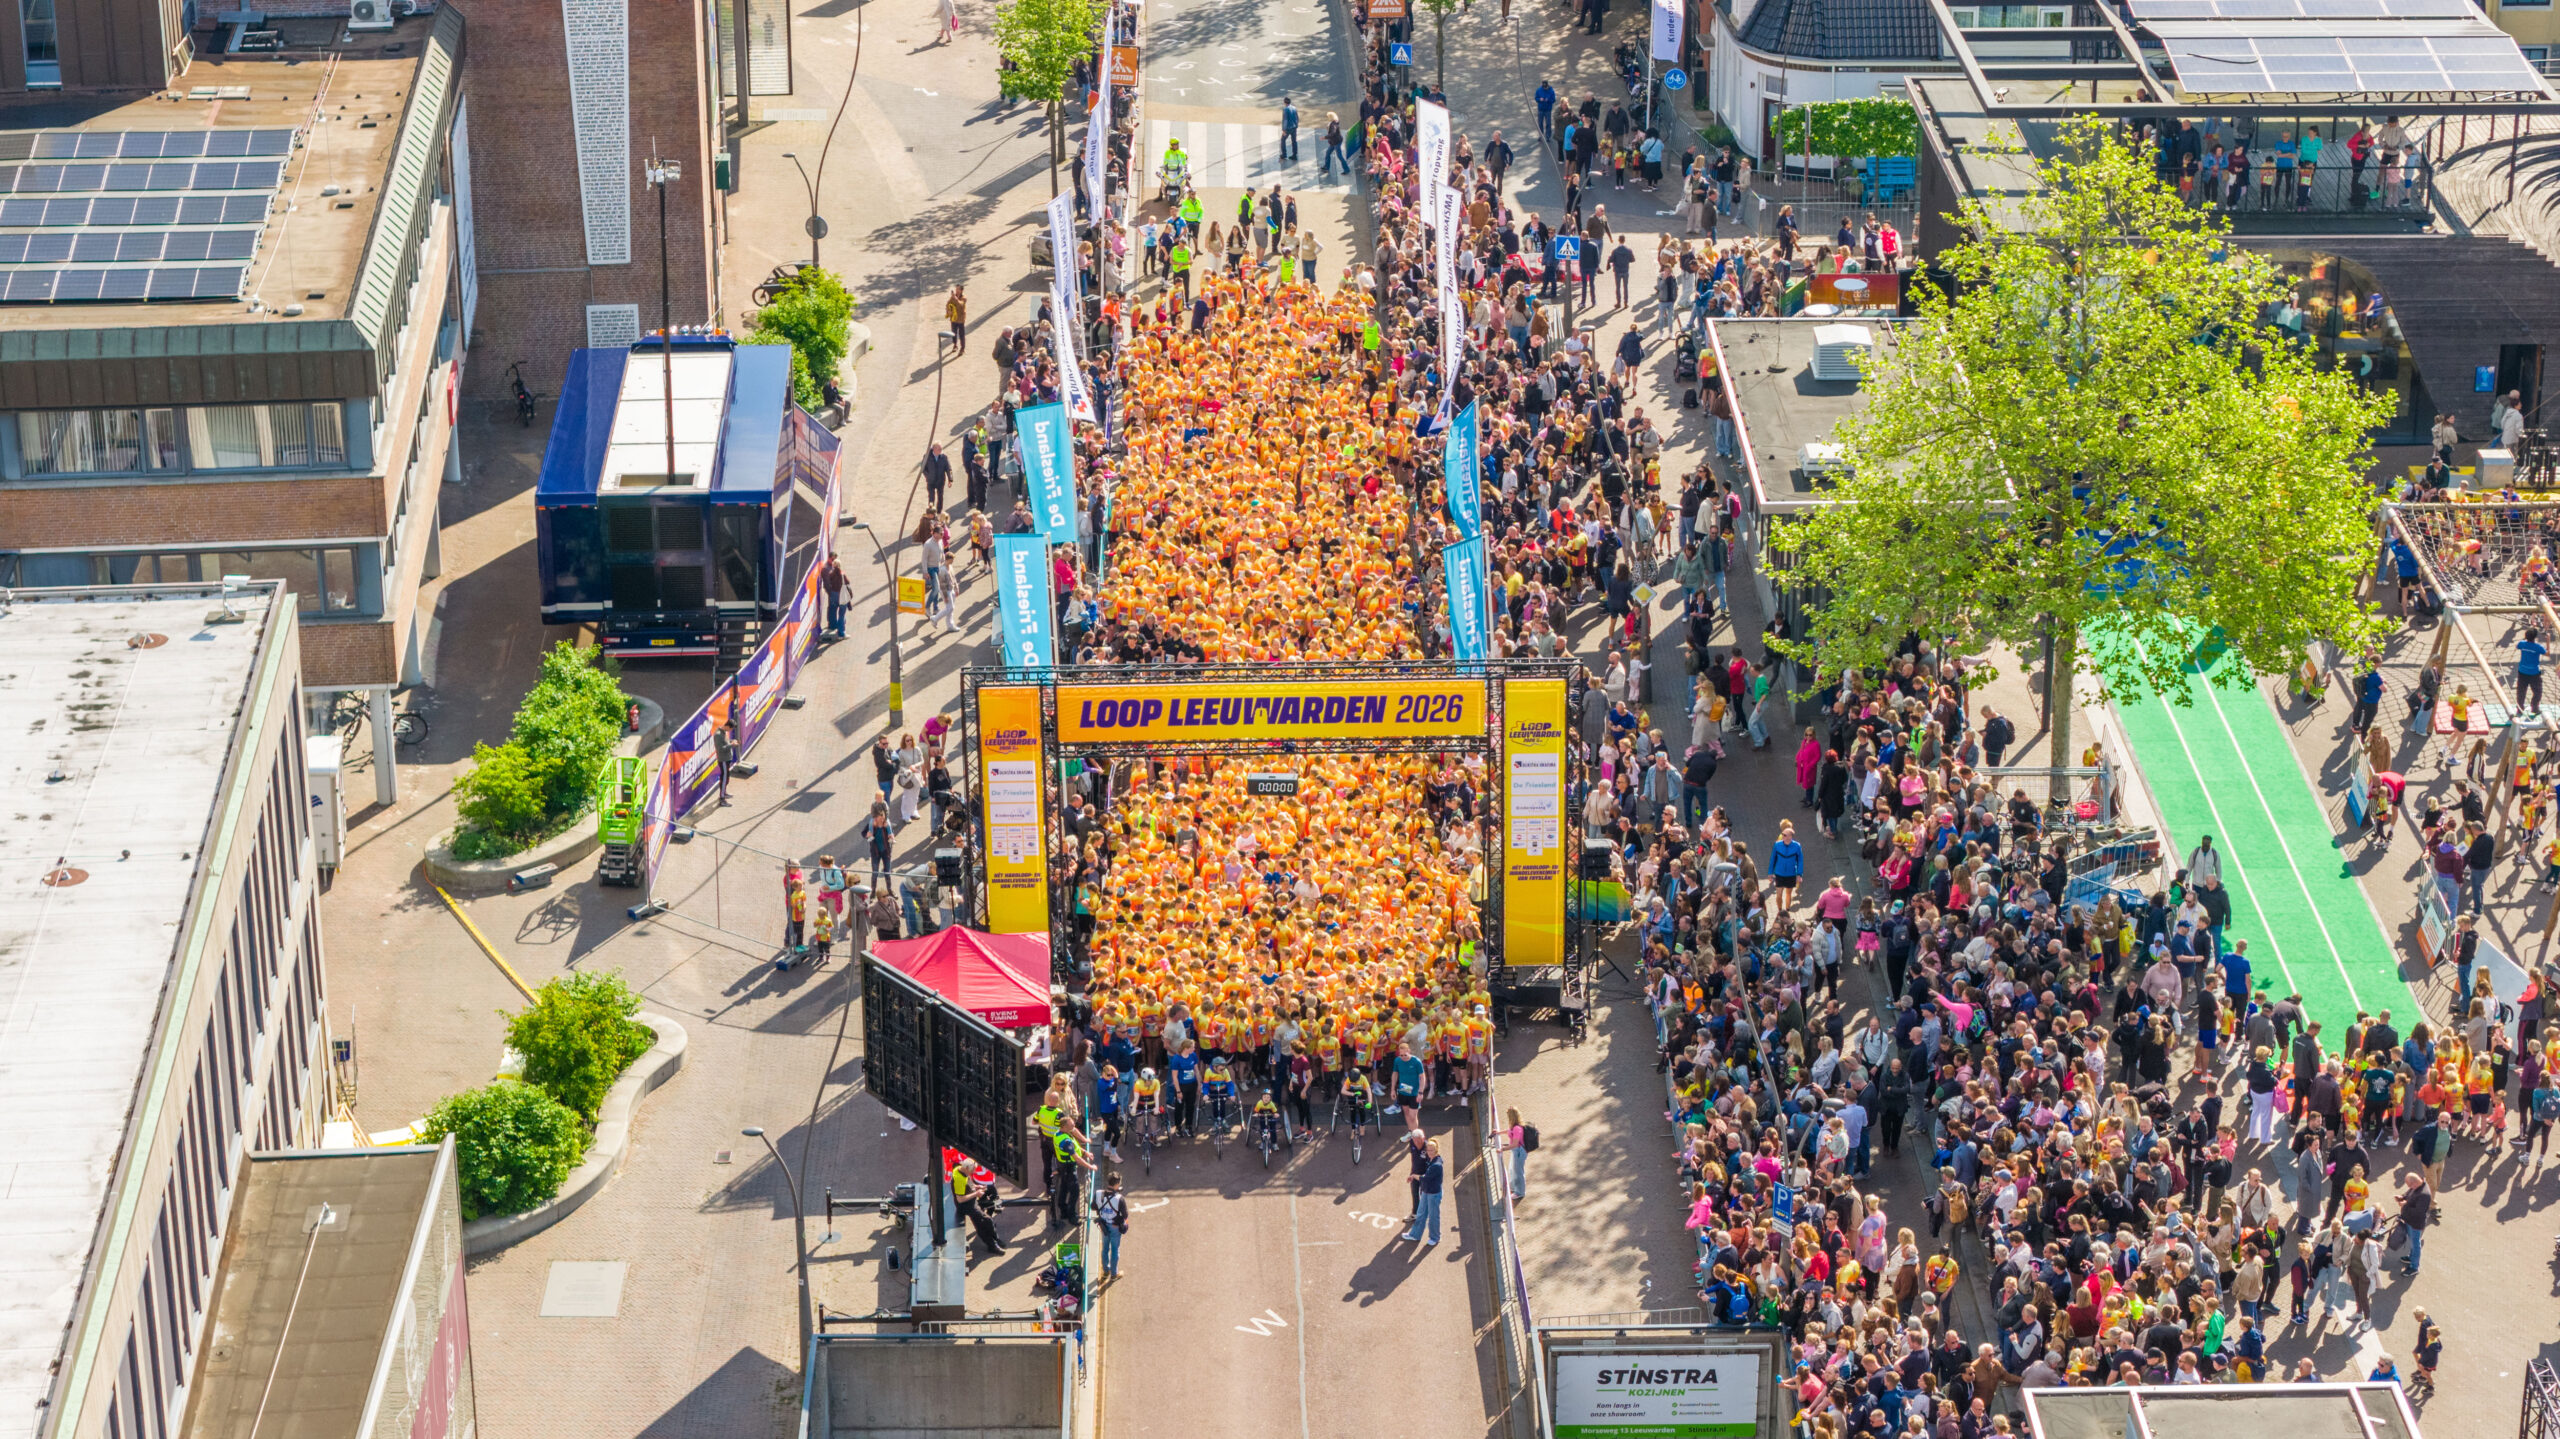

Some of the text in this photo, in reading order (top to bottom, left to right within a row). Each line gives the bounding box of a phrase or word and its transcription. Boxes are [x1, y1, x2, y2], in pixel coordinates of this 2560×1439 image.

[1079, 694, 1464, 728] LOOP LEEUWARDEN 2026
[1521, 723, 1552, 731] LOOP
[996, 730, 1027, 738] LOOP
[1777, 1187, 1789, 1205] P
[1613, 1402, 1632, 1411] langs
[1607, 1410, 1646, 1418] showroom!
